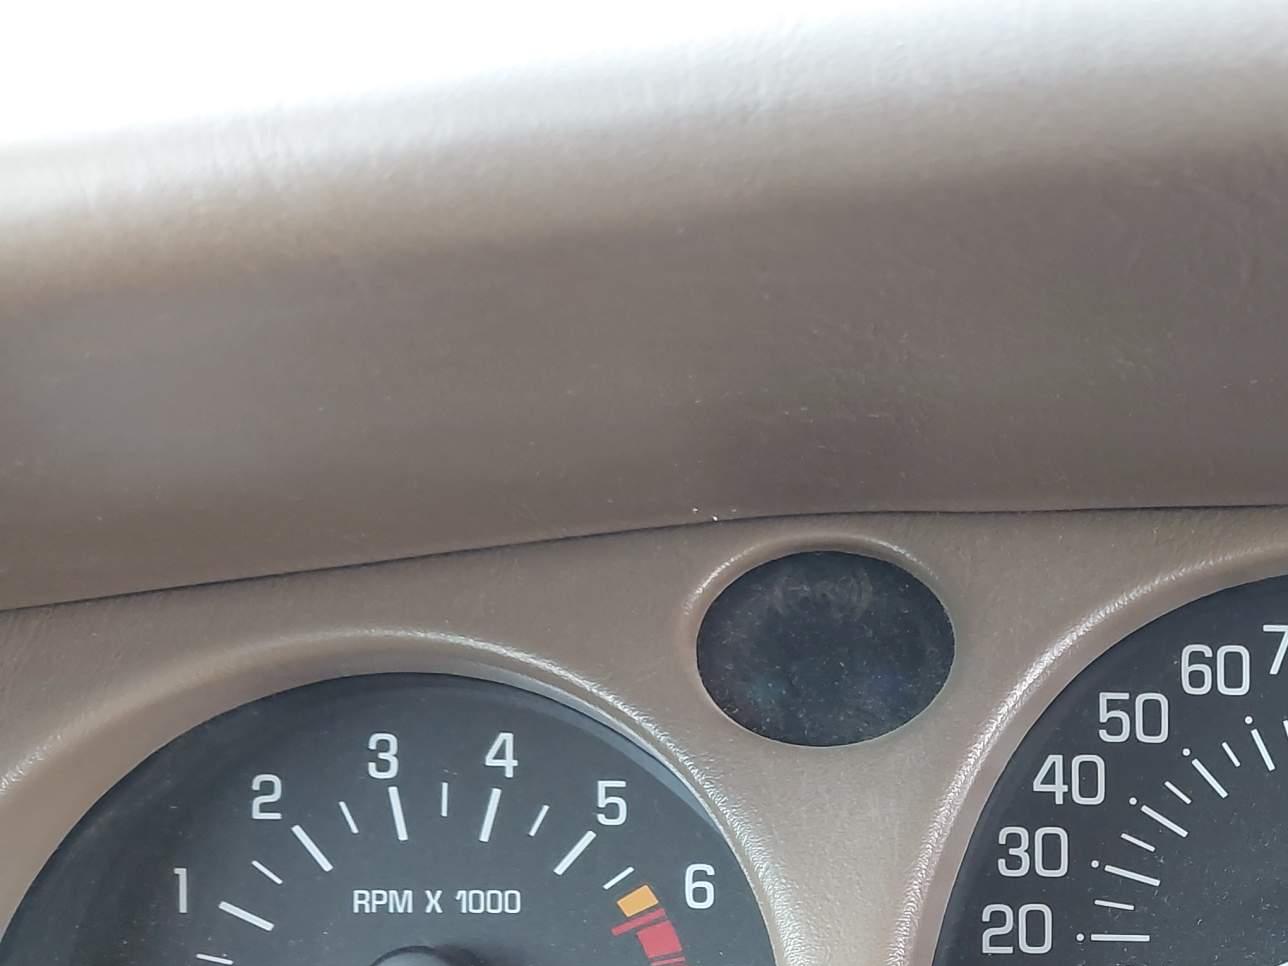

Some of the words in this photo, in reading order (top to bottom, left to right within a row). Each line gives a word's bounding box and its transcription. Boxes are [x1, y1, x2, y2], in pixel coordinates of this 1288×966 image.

[1180, 644, 1250, 696] 60
[1098, 692, 1169, 744] 50
[368, 733, 399, 779] 3
[485, 732, 518, 779] 4
[251, 774, 281, 820] 2
[597, 780, 628, 825] 5
[1033, 754, 1105, 805] 40
[997, 826, 1068, 877] 30
[174, 868, 188, 914] 1
[352, 890, 413, 913] RPM
[425, 890, 442, 913] X
[456, 889, 521, 913] 1000
[684, 863, 715, 909] 6
[981, 904, 1052, 955] 20
